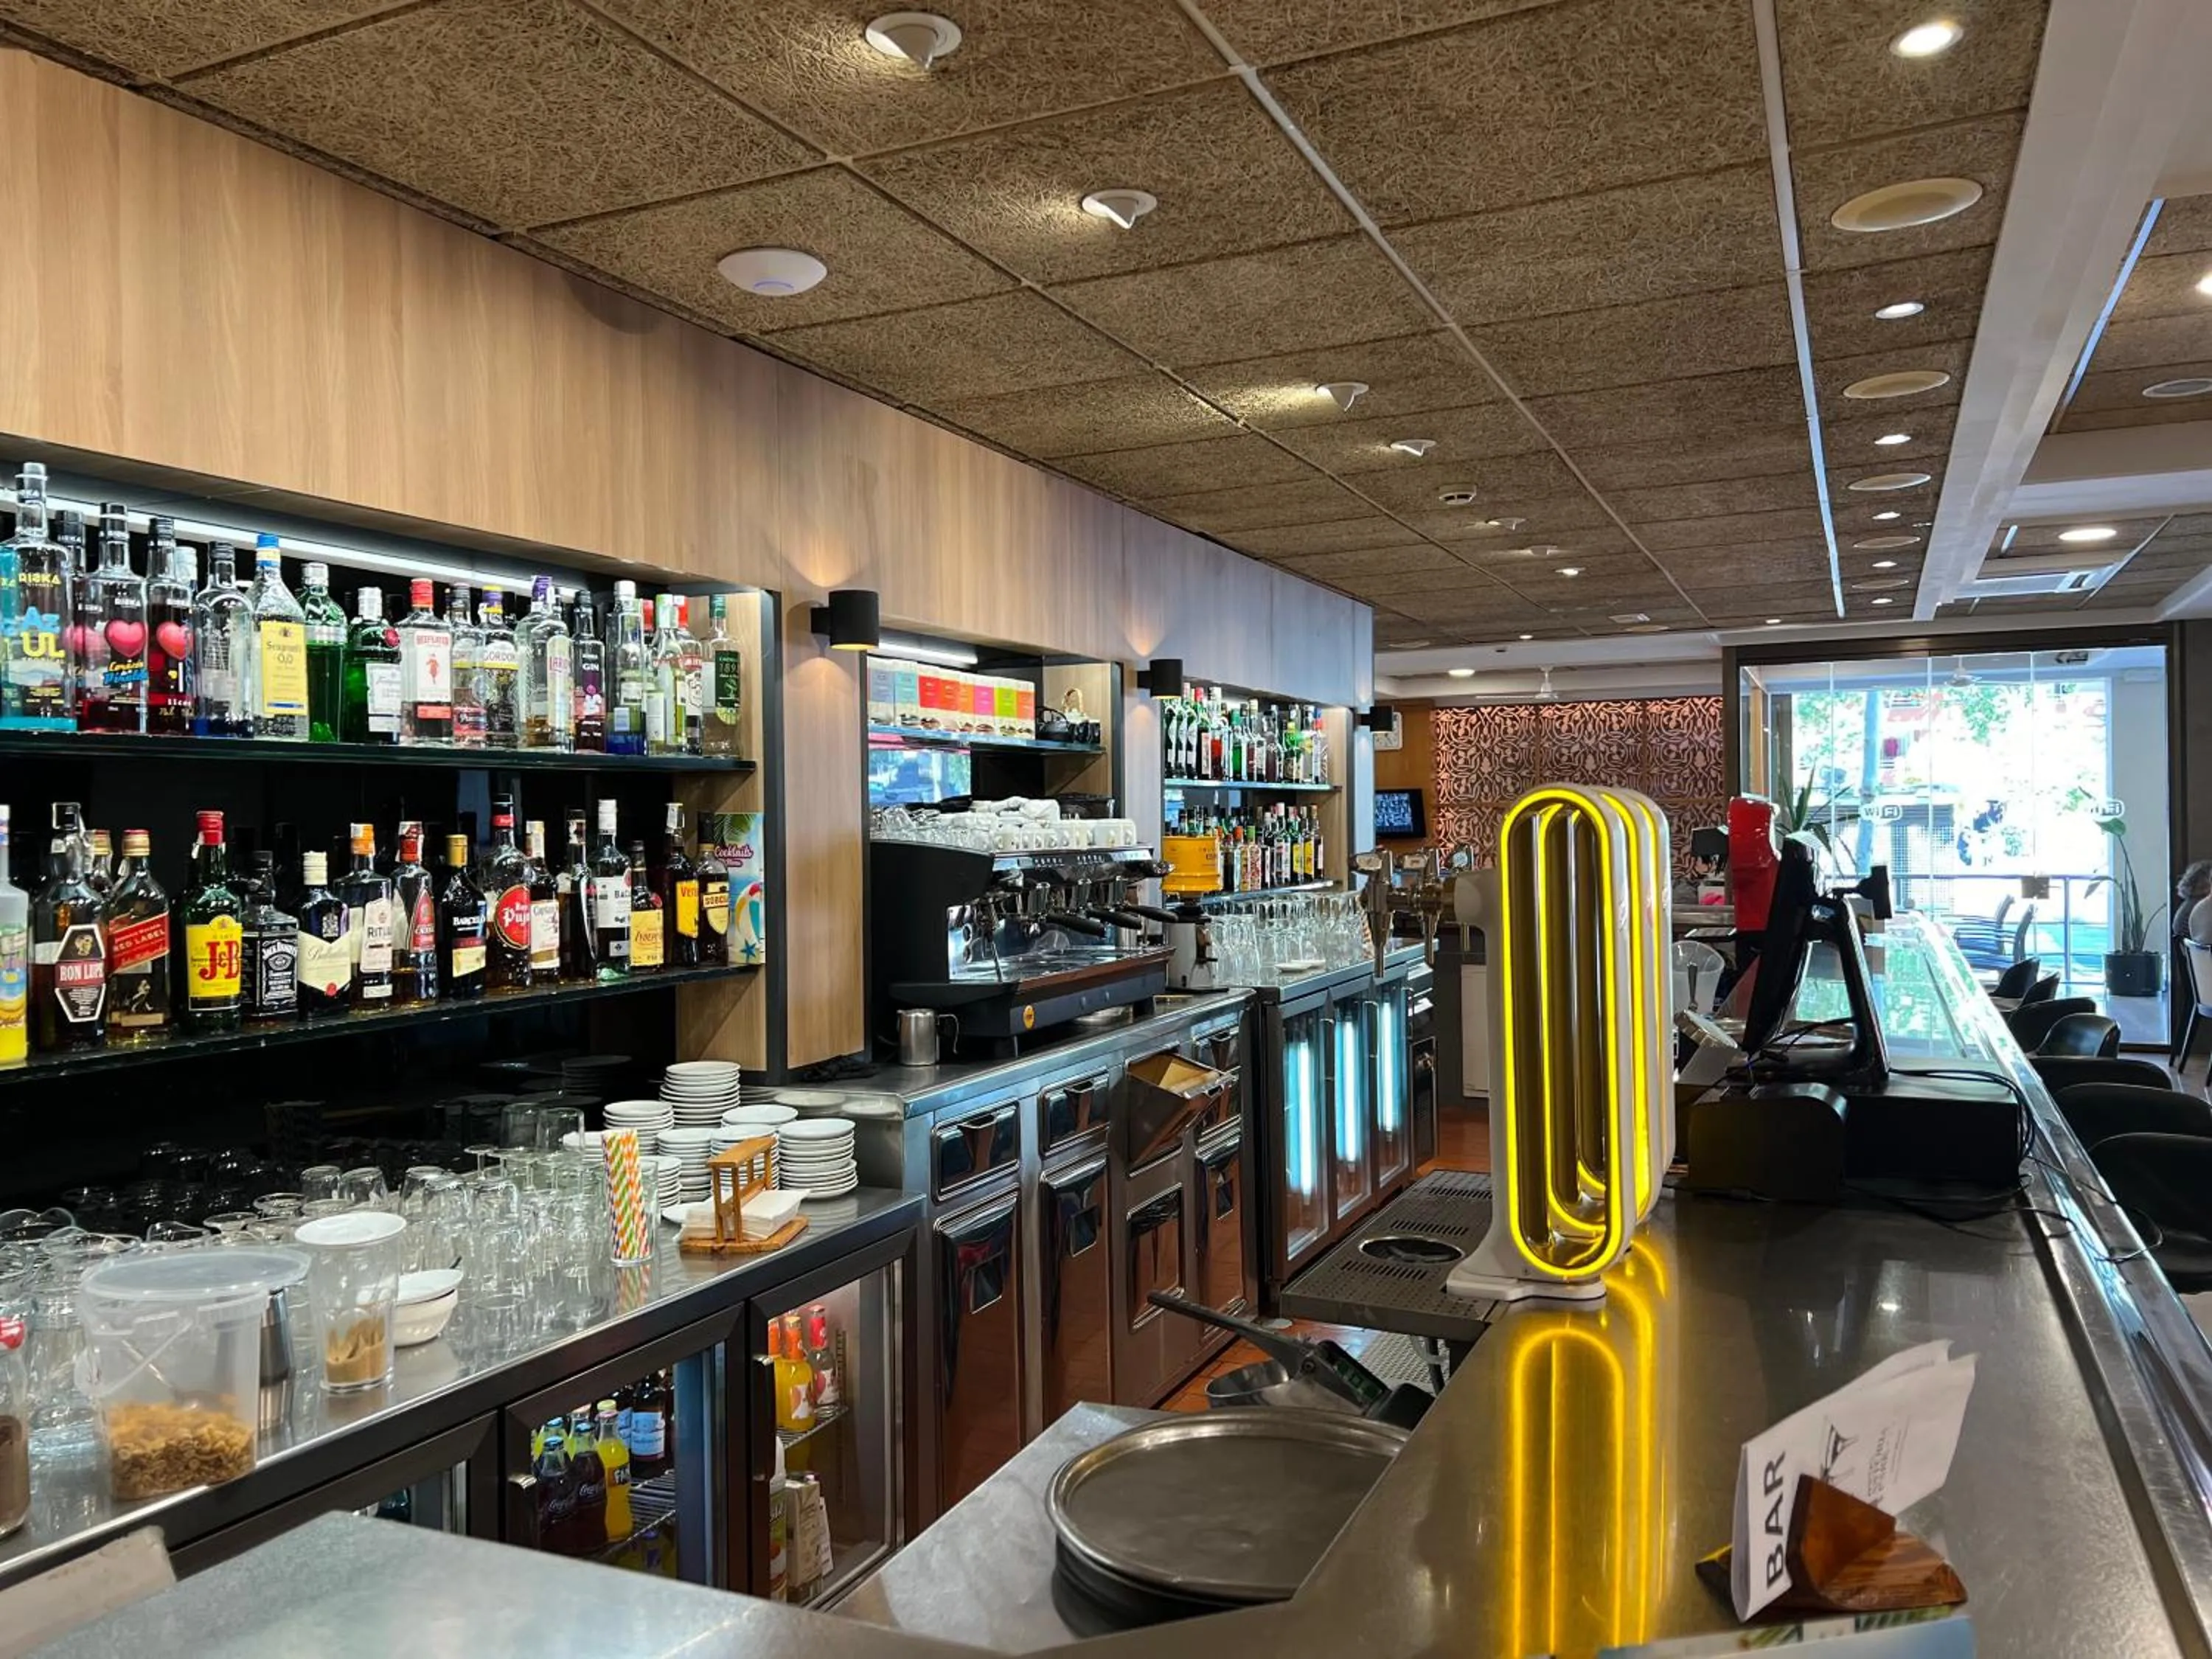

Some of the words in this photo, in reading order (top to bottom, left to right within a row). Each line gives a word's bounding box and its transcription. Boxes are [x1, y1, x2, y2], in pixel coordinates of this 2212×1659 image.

[714, 844, 753, 858] Cocktails
[198, 940, 240, 981] J&B
[1763, 1450, 1785, 1588] BAR
